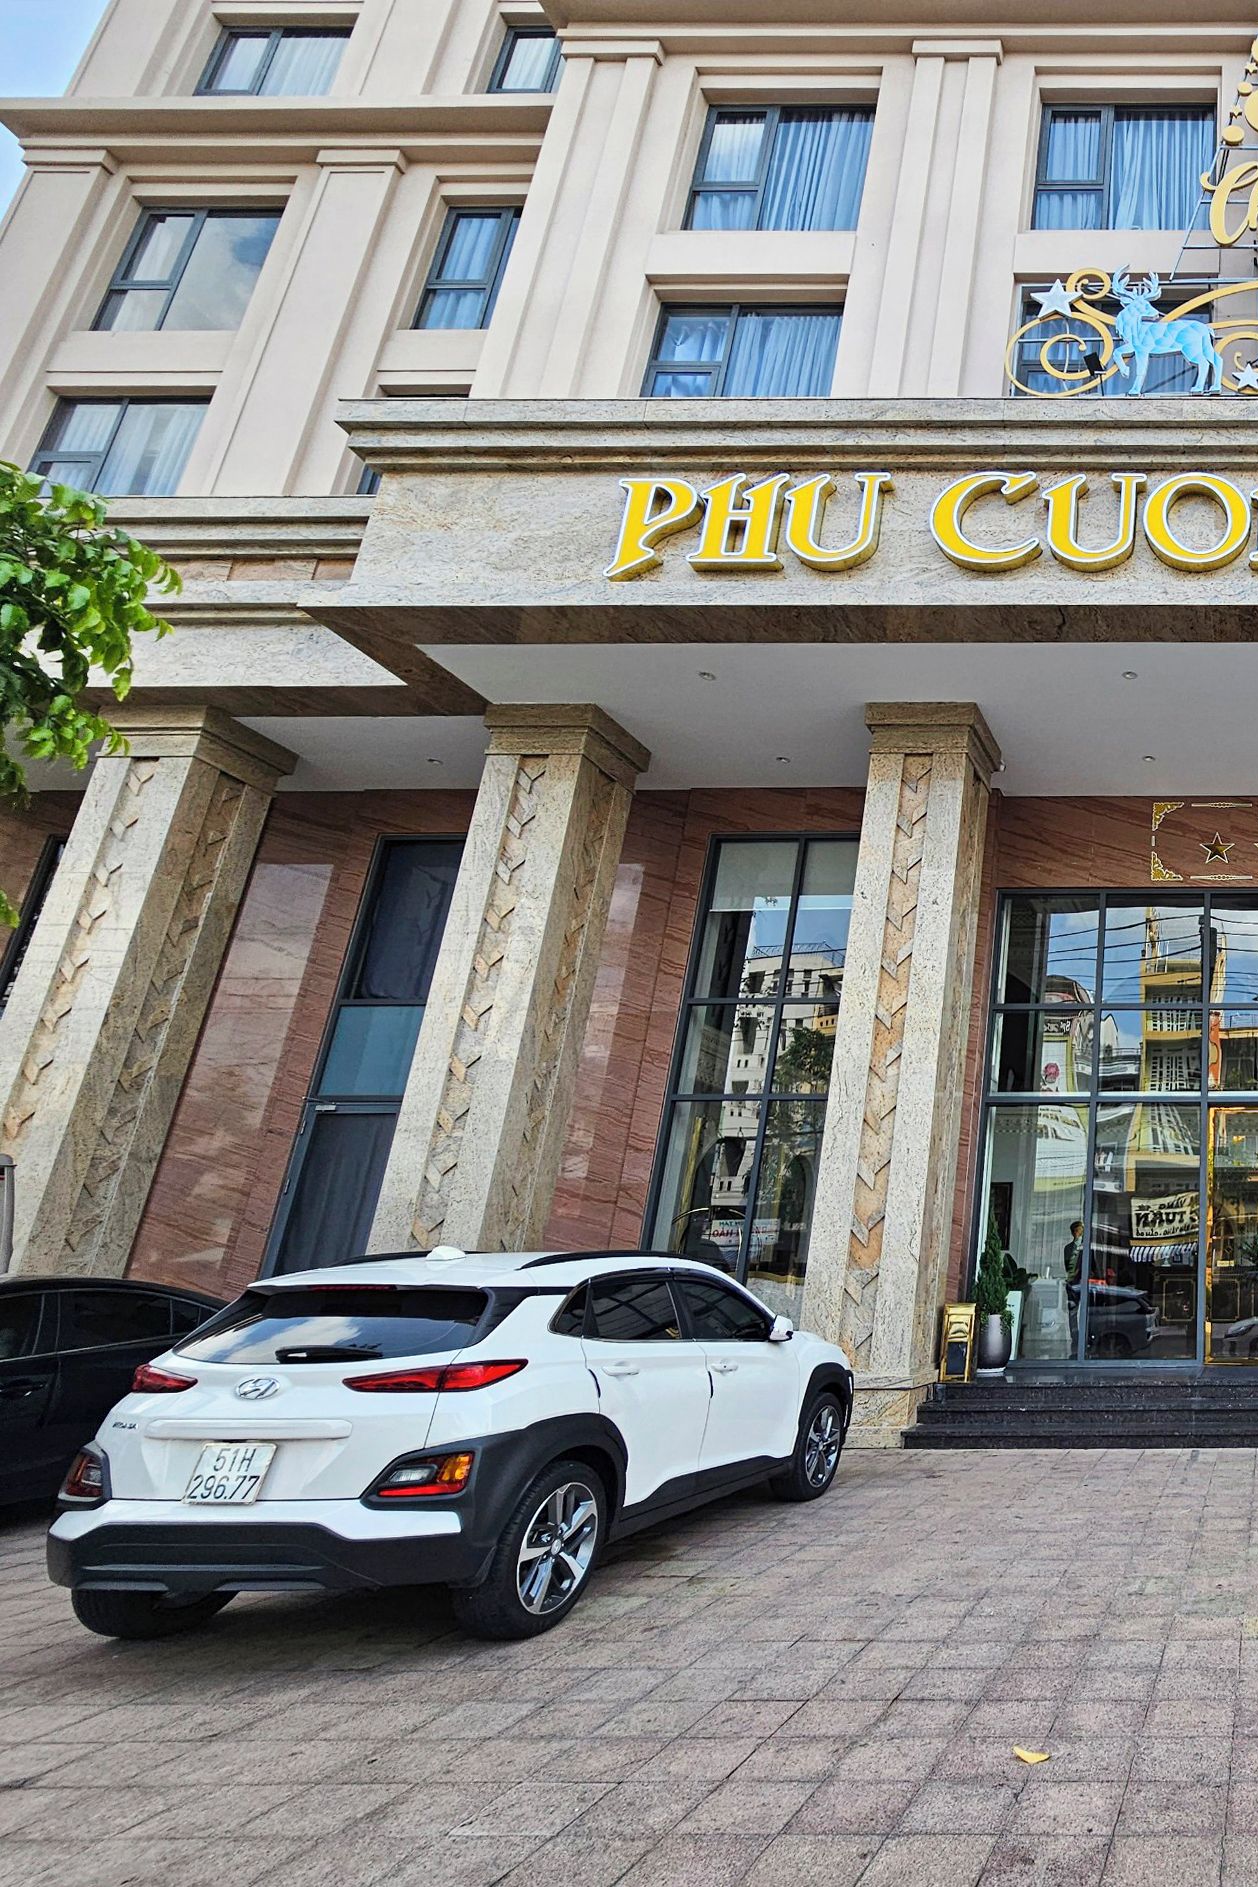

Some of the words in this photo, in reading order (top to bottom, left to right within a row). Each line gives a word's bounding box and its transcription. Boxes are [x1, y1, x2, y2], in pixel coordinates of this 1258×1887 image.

[604, 471, 895, 582] PHU
[213, 1447, 257, 1472] 51H
[186, 1474, 261, 1500] 296.77
